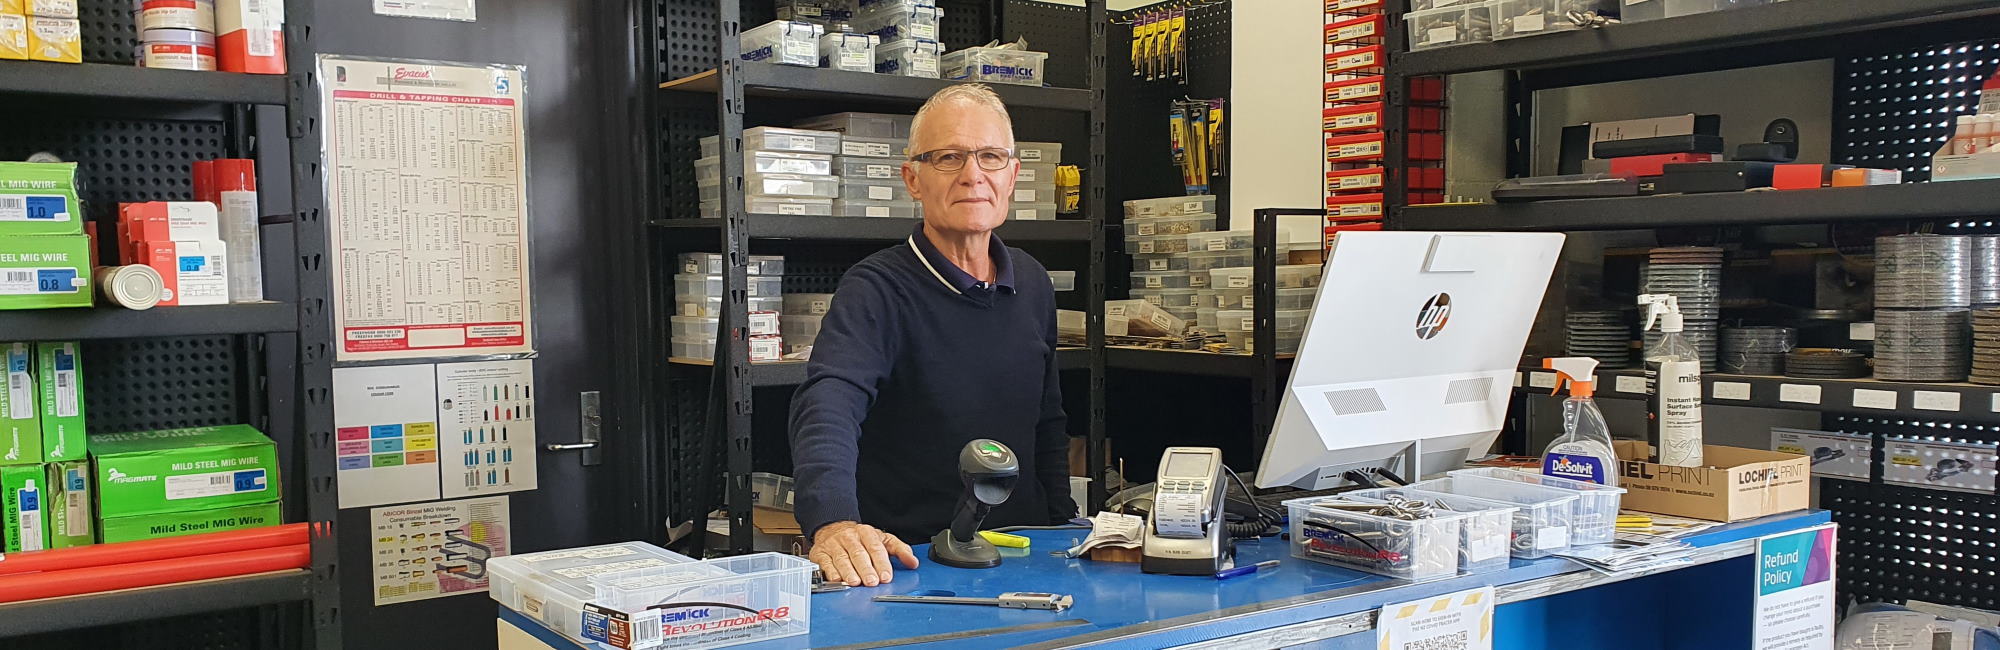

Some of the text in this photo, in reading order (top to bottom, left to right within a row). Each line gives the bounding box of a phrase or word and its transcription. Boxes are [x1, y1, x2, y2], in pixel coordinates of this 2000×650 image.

[982, 64, 1033, 76] BREMICK
[8, 180, 28, 188] MIG
[28, 206, 46, 218] 1.0
[0, 253, 68, 262] EEL MIG WIRE
[40, 278, 59, 290] 0.8
[1417, 294, 1451, 339] hp
[172, 456, 259, 471] MILD STEEL MIG WIRE
[1658, 465, 1711, 486] PRINT
[1780, 464, 1804, 478] PRINT
[236, 480, 250, 490] 0.9
[150, 516, 264, 534] Mild Steel MIG Wire
[10, 526, 18, 546] Steel
[1764, 549, 1799, 569] Refund
[1764, 570, 1792, 587] Policy
[661, 608, 709, 623] REMICK
[757, 606, 789, 620] B8
